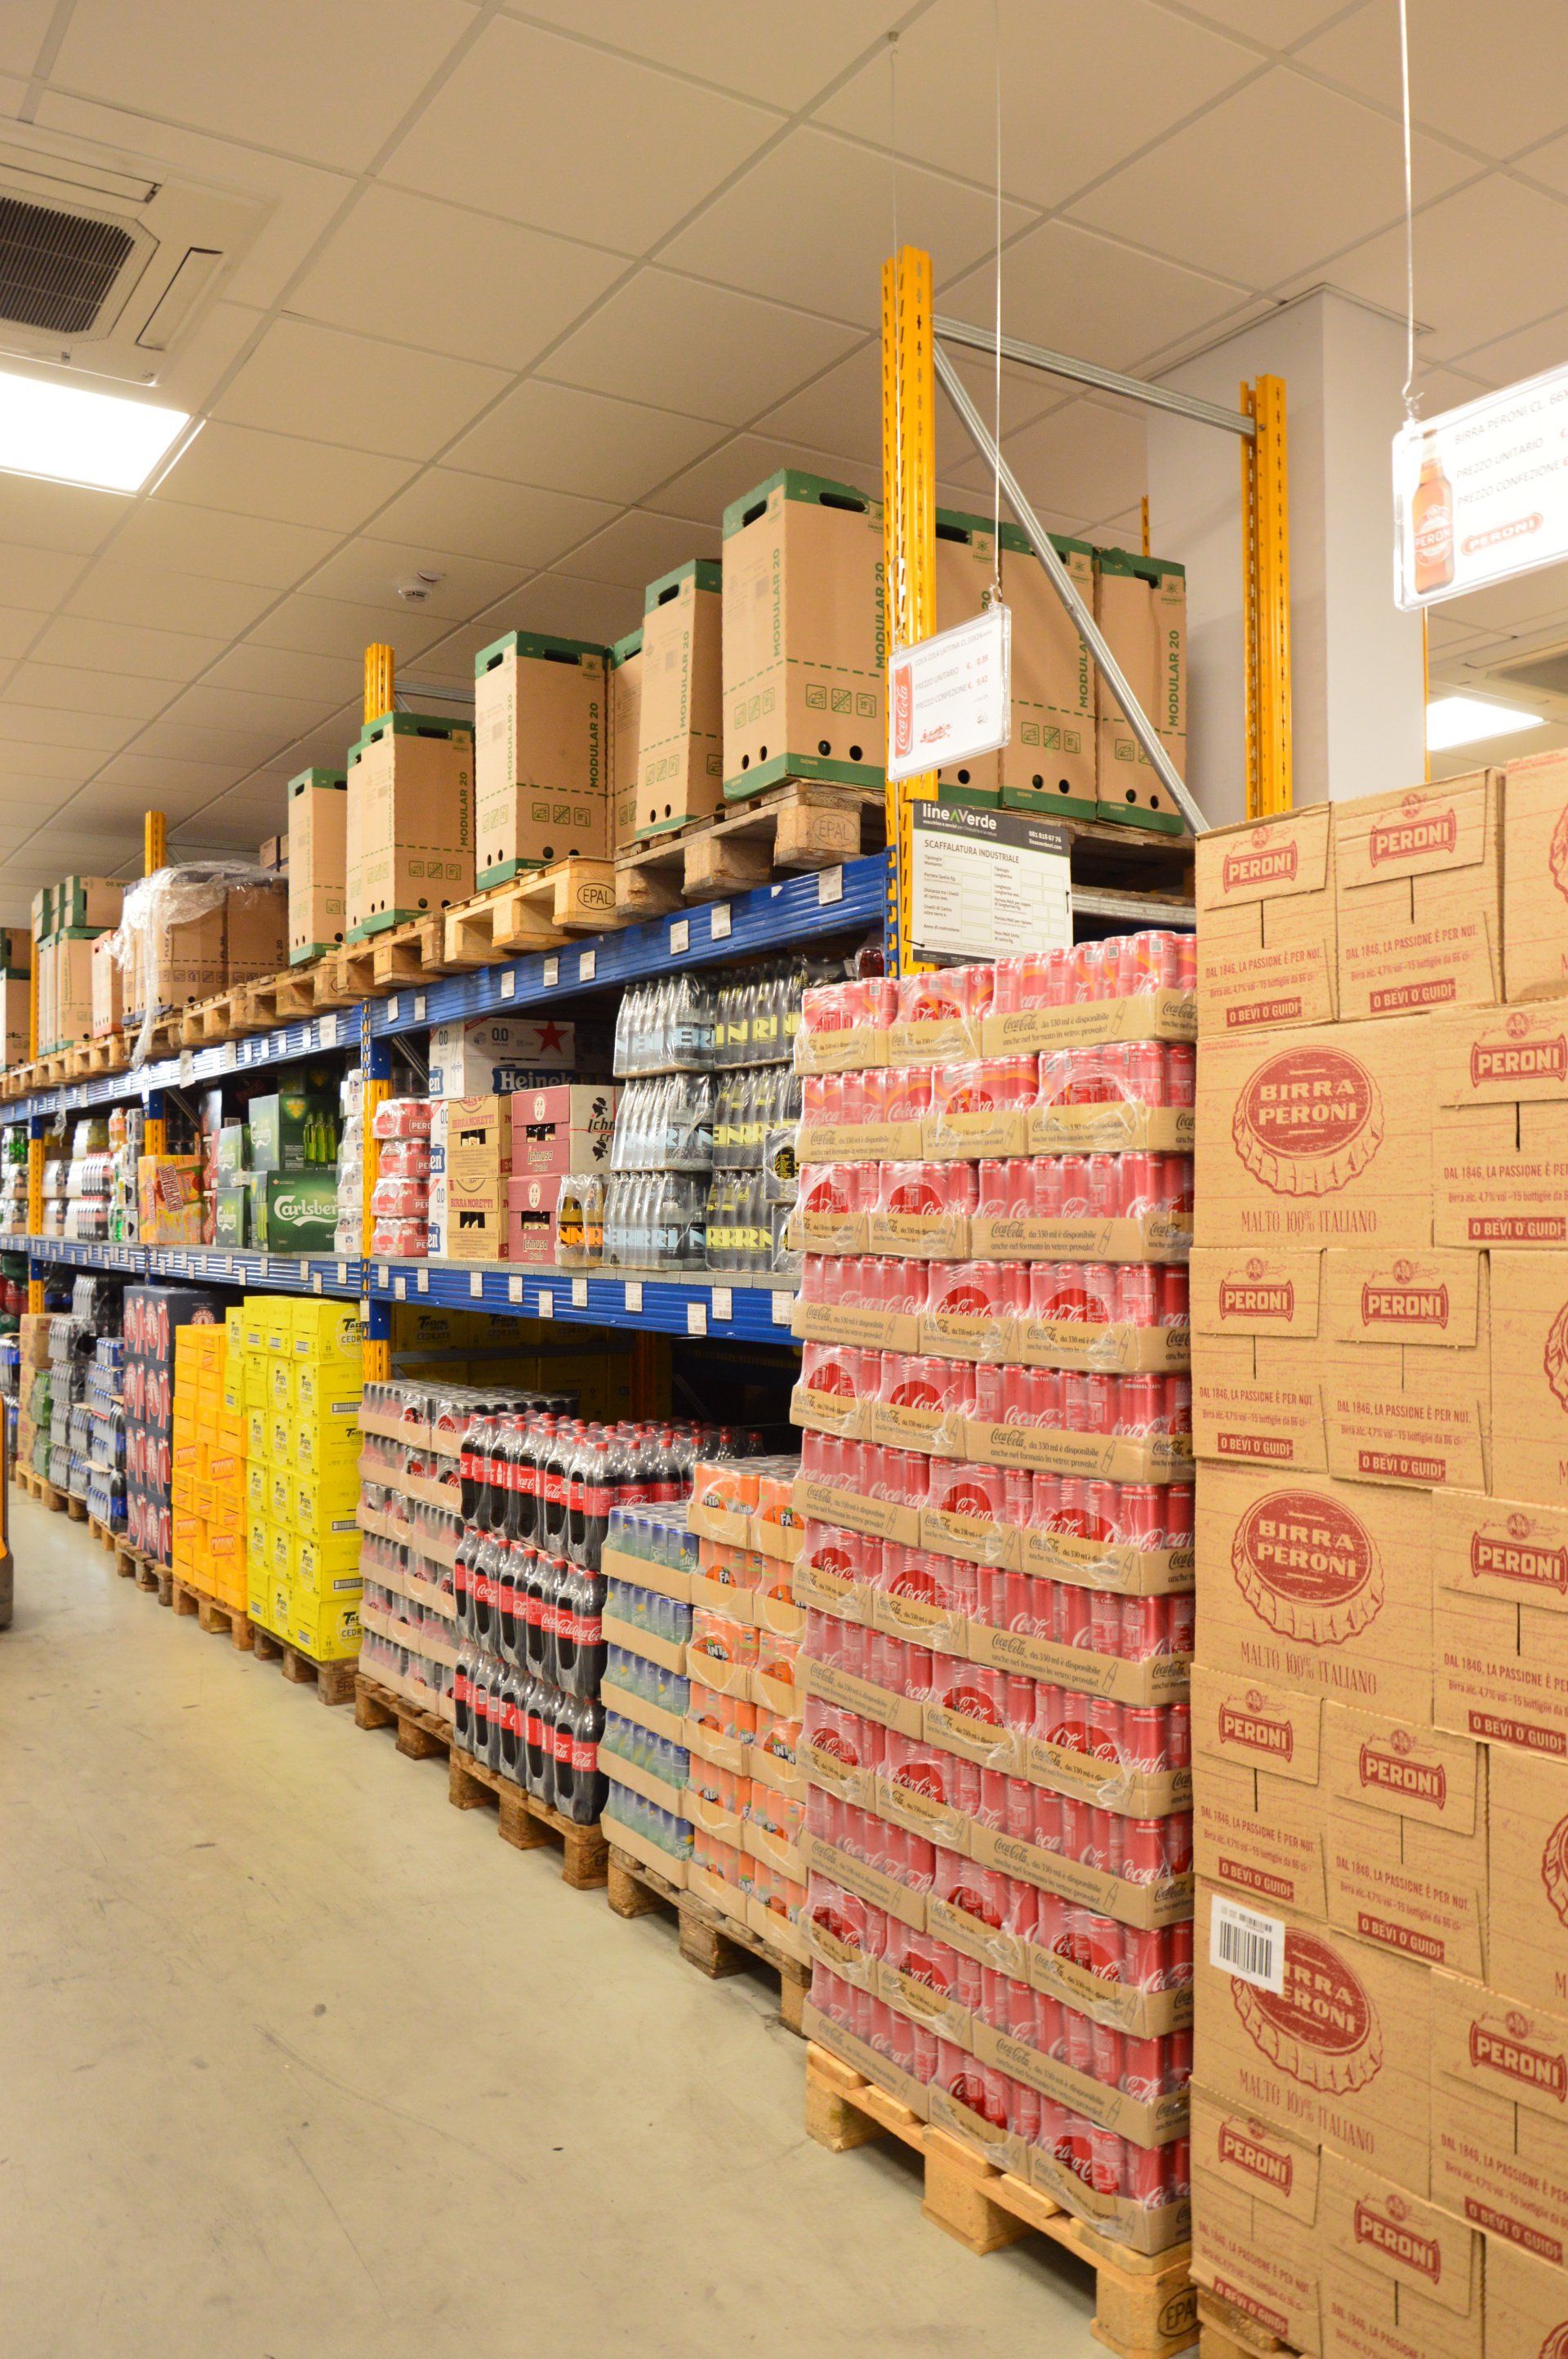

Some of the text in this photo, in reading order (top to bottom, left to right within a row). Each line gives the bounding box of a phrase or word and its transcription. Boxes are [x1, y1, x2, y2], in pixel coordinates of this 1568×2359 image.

[1454, 425, 1485, 444] BIRRA
[1488, 406, 1527, 430] PERONI
[1456, 458, 1492, 479] PREZZO
[1494, 438, 1544, 464] UNITARIO
[1458, 460, 1559, 506] PREZZO CONFEZIONE
[1470, 519, 1535, 549] PERONI
[773, 548, 780, 569] 20
[875, 562, 885, 669] MODULAR 20
[680, 631, 689, 729] MODULAR 20
[915, 678, 933, 690] PREZZO
[934, 667, 959, 683] UNITARIO
[1169, 630, 1179, 727] MODULAR 20
[915, 698, 934, 710] PREZZO
[934, 684, 967, 702] CONFEZIONE
[590, 702, 599, 788] MODULAR 20
[460, 772, 468, 846] MODULAR 20
[819, 820, 852, 840] EPAL
[1376, 827, 1451, 854] PERONI
[924, 840, 1019, 863] SCAFFALATURA INDUSTRIALE
[1227, 852, 1293, 881] PERONI
[582, 888, 616, 905] EPAL
[1206, 968, 1217, 979] DAL
[1239, 961, 1247, 972] LA
[1290, 952, 1304, 963] PER
[1230, 1002, 1298, 1023] O BEVI O GUIDI
[1476, 1046, 1562, 1076] PERONI
[500, 1070, 572, 1090] Heinek
[1260, 1081, 1356, 1101] BIRRA
[452, 1114, 494, 1128] BIRRA MORETTI
[588, 1114, 615, 1133] ichn
[1258, 1103, 1357, 1126] PERONI
[158, 1165, 183, 1213] DESPERADOS
[451, 1198, 493, 1208] BIRRA MORETTI
[274, 1195, 337, 1224] Carlsber
[1241, 1209, 1377, 1233] MALTO 100% ITALIANO
[1472, 1222, 1561, 1236] O BEVI O GUIDI
[1224, 1289, 1290, 1311] PERONI
[1367, 1294, 1442, 1318] PERONI
[341, 1335, 361, 1344] CEDR
[1338, 1400, 1350, 1412] DAL
[1375, 1403, 1383, 1415] LA
[1428, 1405, 1432, 1420] È
[1435, 1409, 1451, 1421] PER
[1009, 1451, 1018, 1459] nel
[1064, 1446, 1099, 1456] disponibile
[1362, 1456, 1442, 1477] O BEVI O GUIDI
[1258, 1519, 1355, 1552] BIRRA
[1257, 1544, 1357, 1578] PERONI
[1477, 1546, 1562, 1581] PERONI
[1241, 1640, 1377, 1696] MALTO 100% ITALIANO
[1223, 1716, 1289, 1750] PERONI
[1365, 1758, 1441, 1797] PERONI
[1284, 1962, 1354, 2006] IRRA
[1258, 1981, 1356, 2033] ERONI
[1476, 2036, 1561, 2087] PERONI
[1223, 2138, 1287, 2185] PERONI
[1360, 2215, 1437, 2269] PERONI
[1165, 2299, 1198, 2328] EPA
